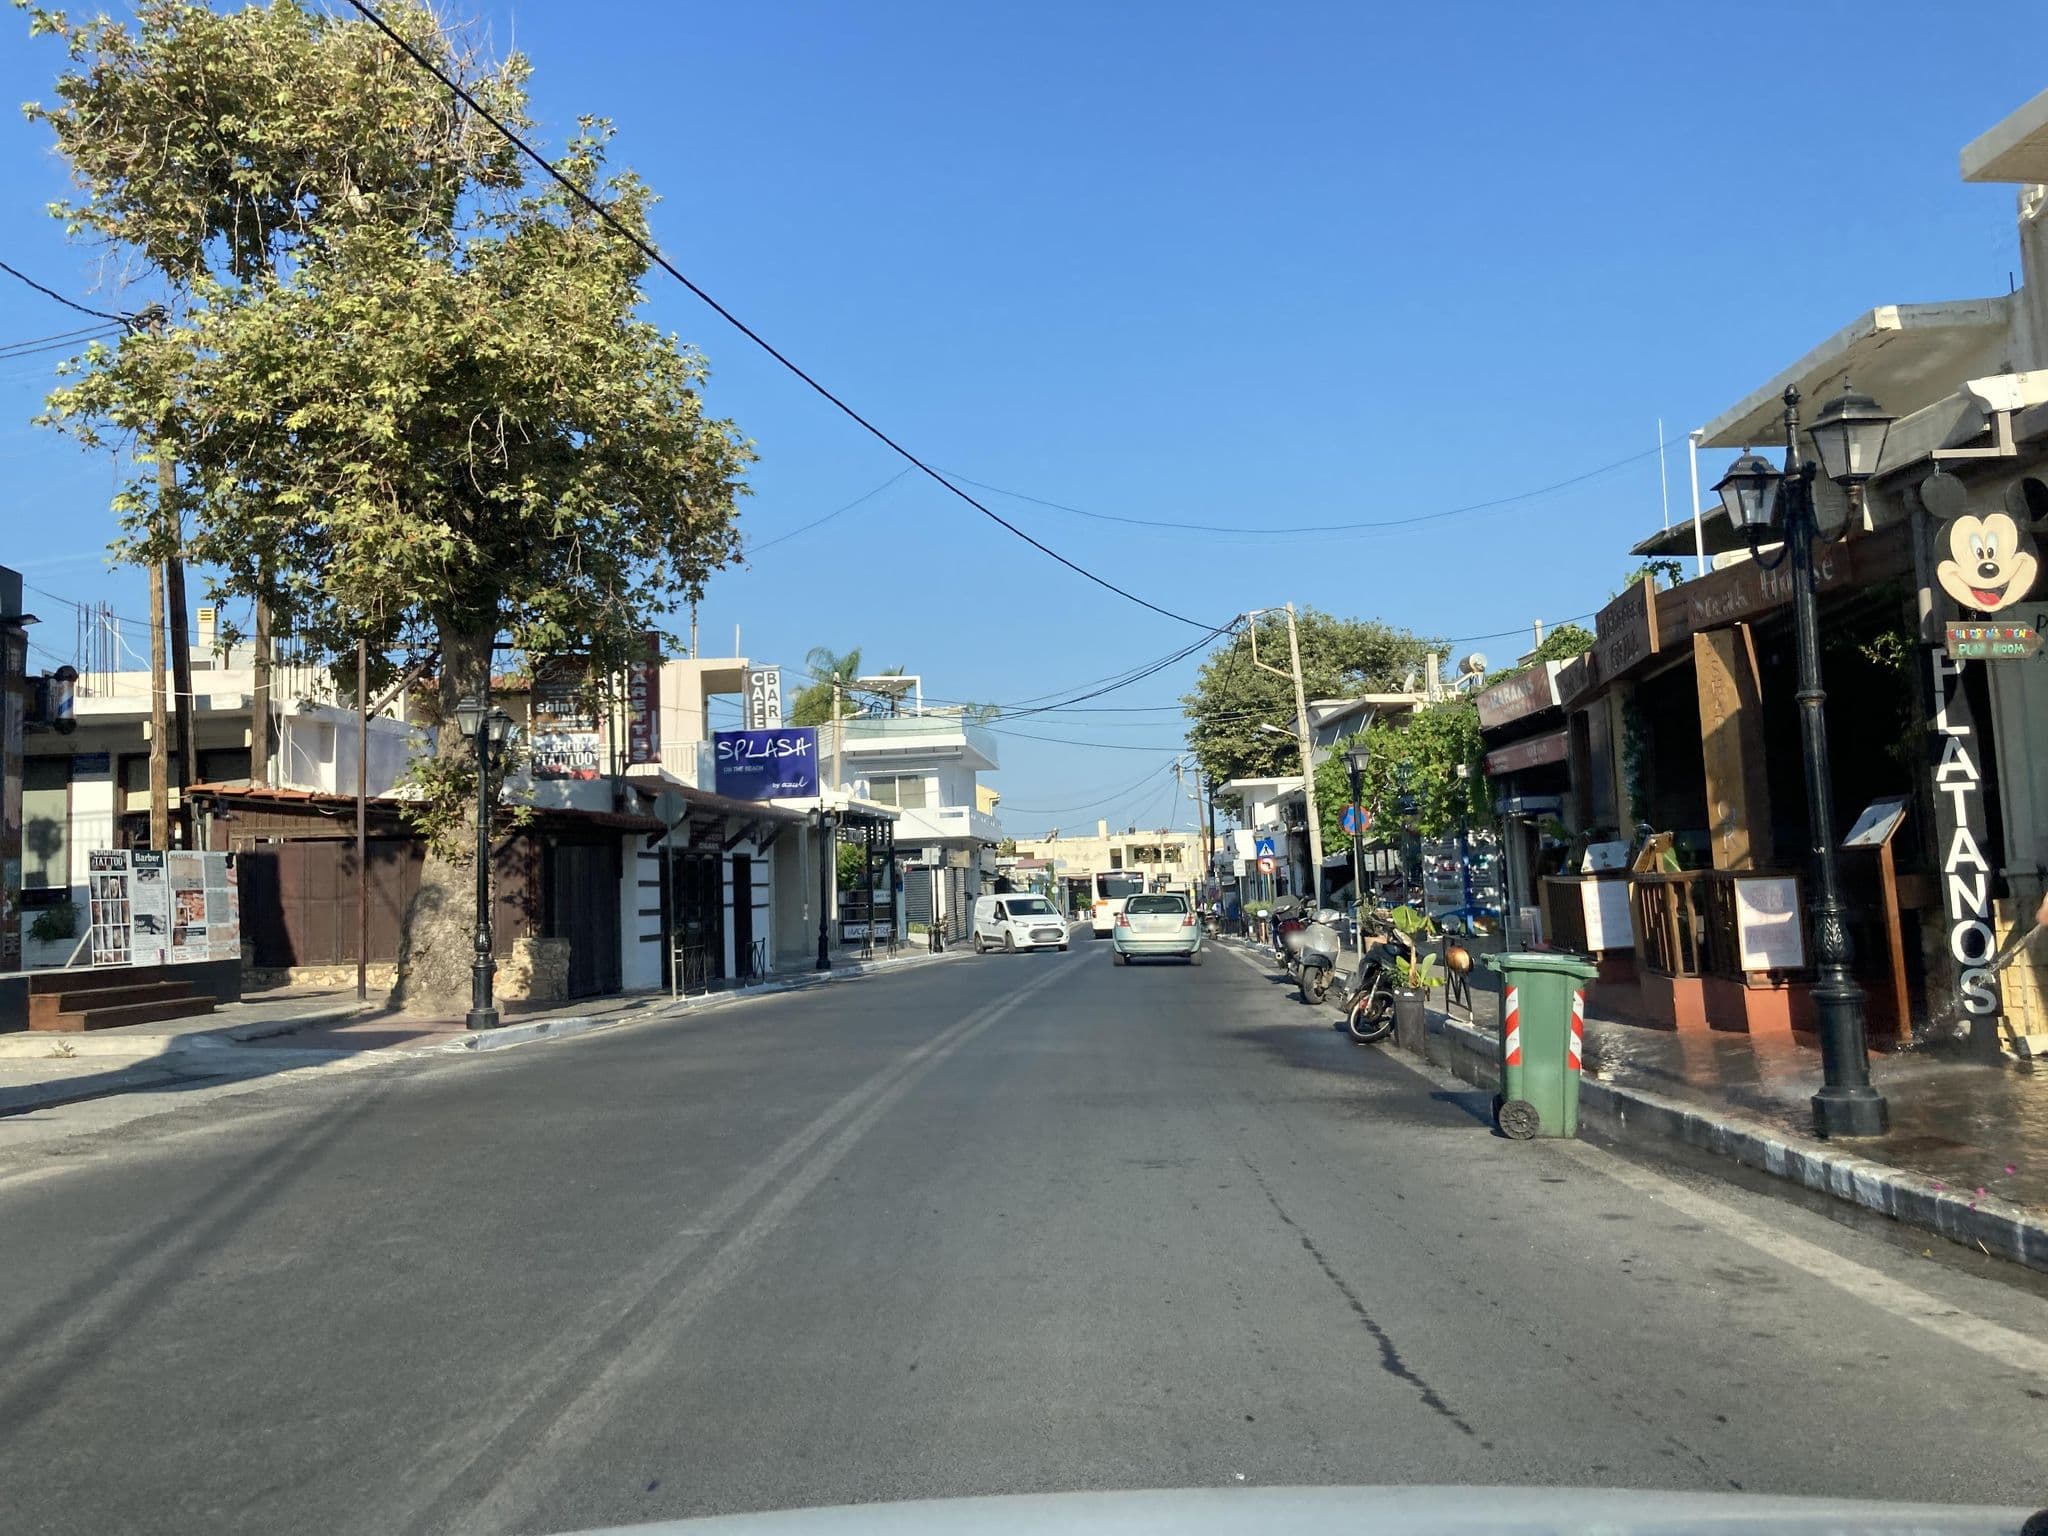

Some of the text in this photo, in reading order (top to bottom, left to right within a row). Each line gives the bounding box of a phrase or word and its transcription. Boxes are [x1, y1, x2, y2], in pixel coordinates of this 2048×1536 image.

[751, 672, 764, 728] CAFE
[767, 673, 778, 717] BAR
[536, 700, 579, 714] shiny
[718, 737, 812, 760] SPLASH
[1931, 649, 1998, 1014] PLATANOS
[94, 857, 123, 866] TATTOO
[135, 853, 160, 862] Barber
